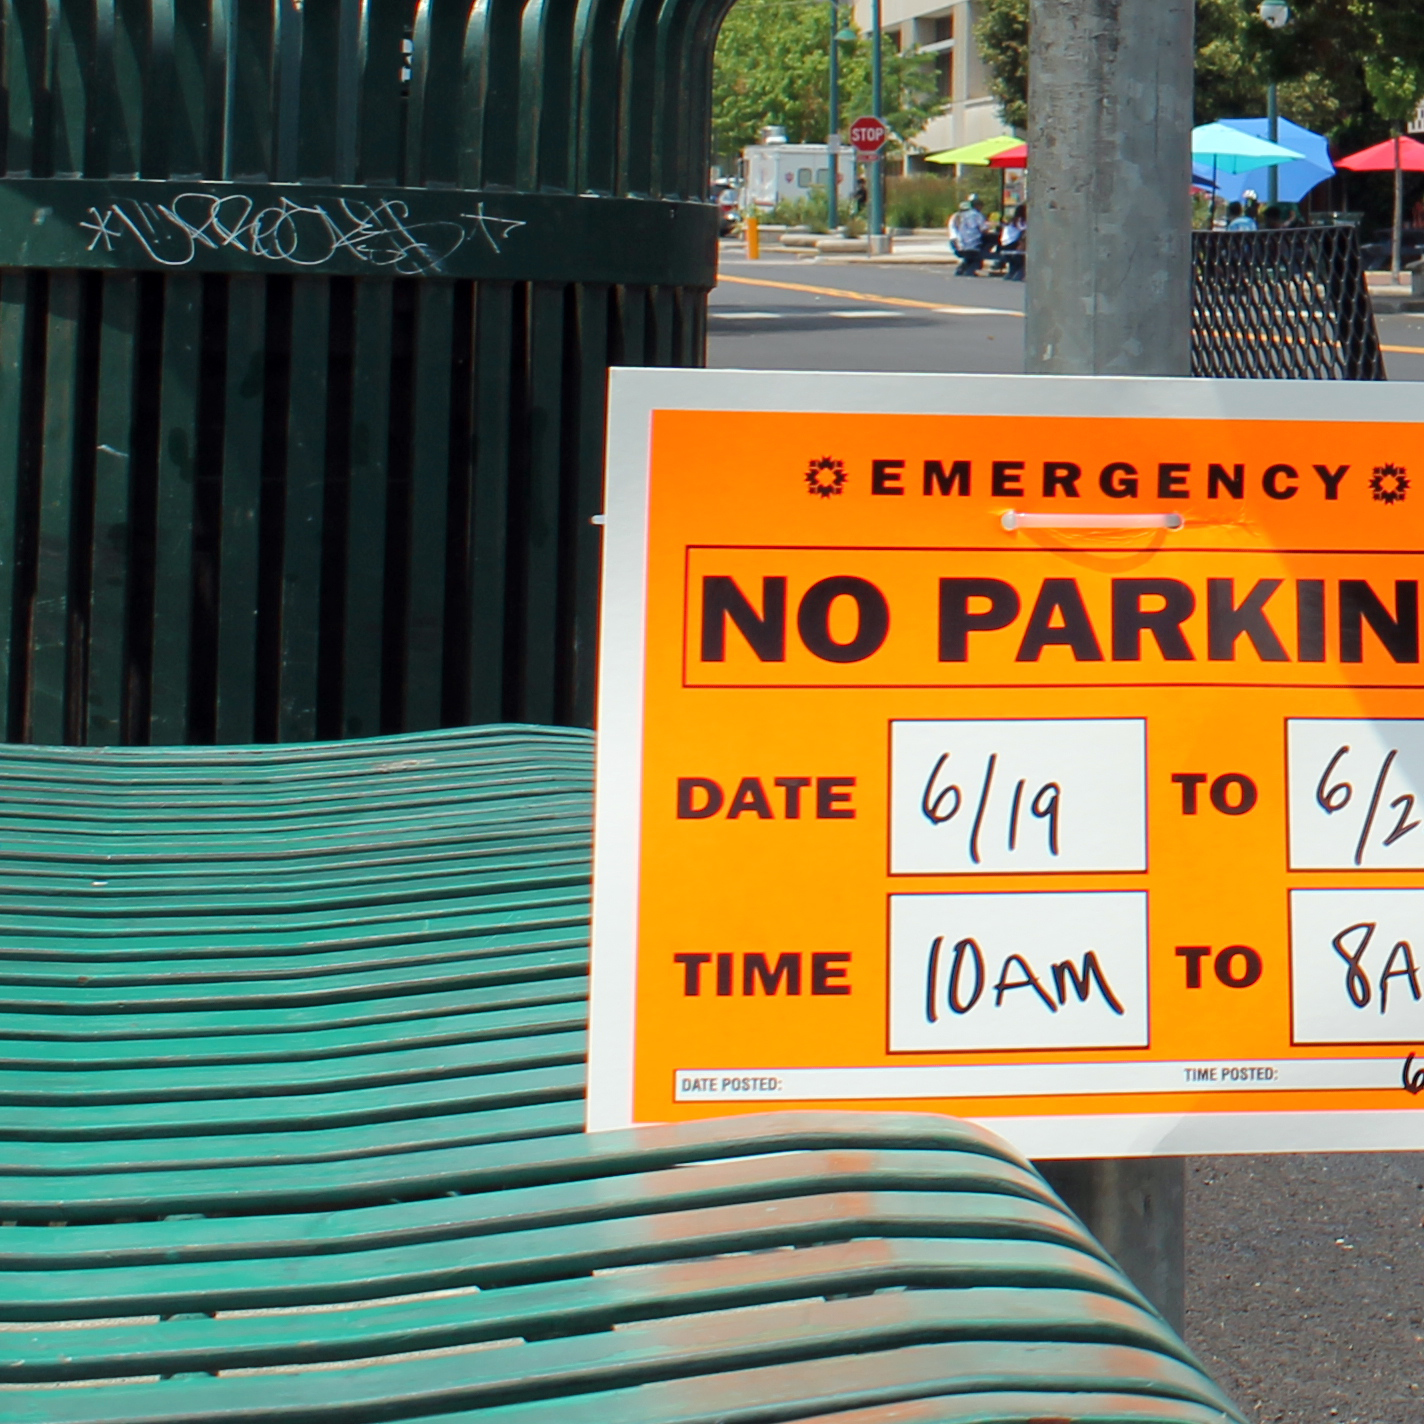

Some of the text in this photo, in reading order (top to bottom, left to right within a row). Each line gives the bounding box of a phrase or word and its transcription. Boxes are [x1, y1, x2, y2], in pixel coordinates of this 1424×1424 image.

[851, 127, 884, 142] STOP
[871, 458, 1352, 501] EMERGENCY
[700, 574, 889, 662] NO
[676, 776, 857, 821] DATE
[920, 751, 1061, 862] 6/19
[1170, 772, 1258, 816] TO
[674, 951, 852, 996] TIME
[926, 936, 1125, 1023] 10AM
[1175, 945, 1263, 989] TO
[681, 1077, 783, 1093] DATE POSTED:
[1183, 1066, 1279, 1083] TIME POSTED:
